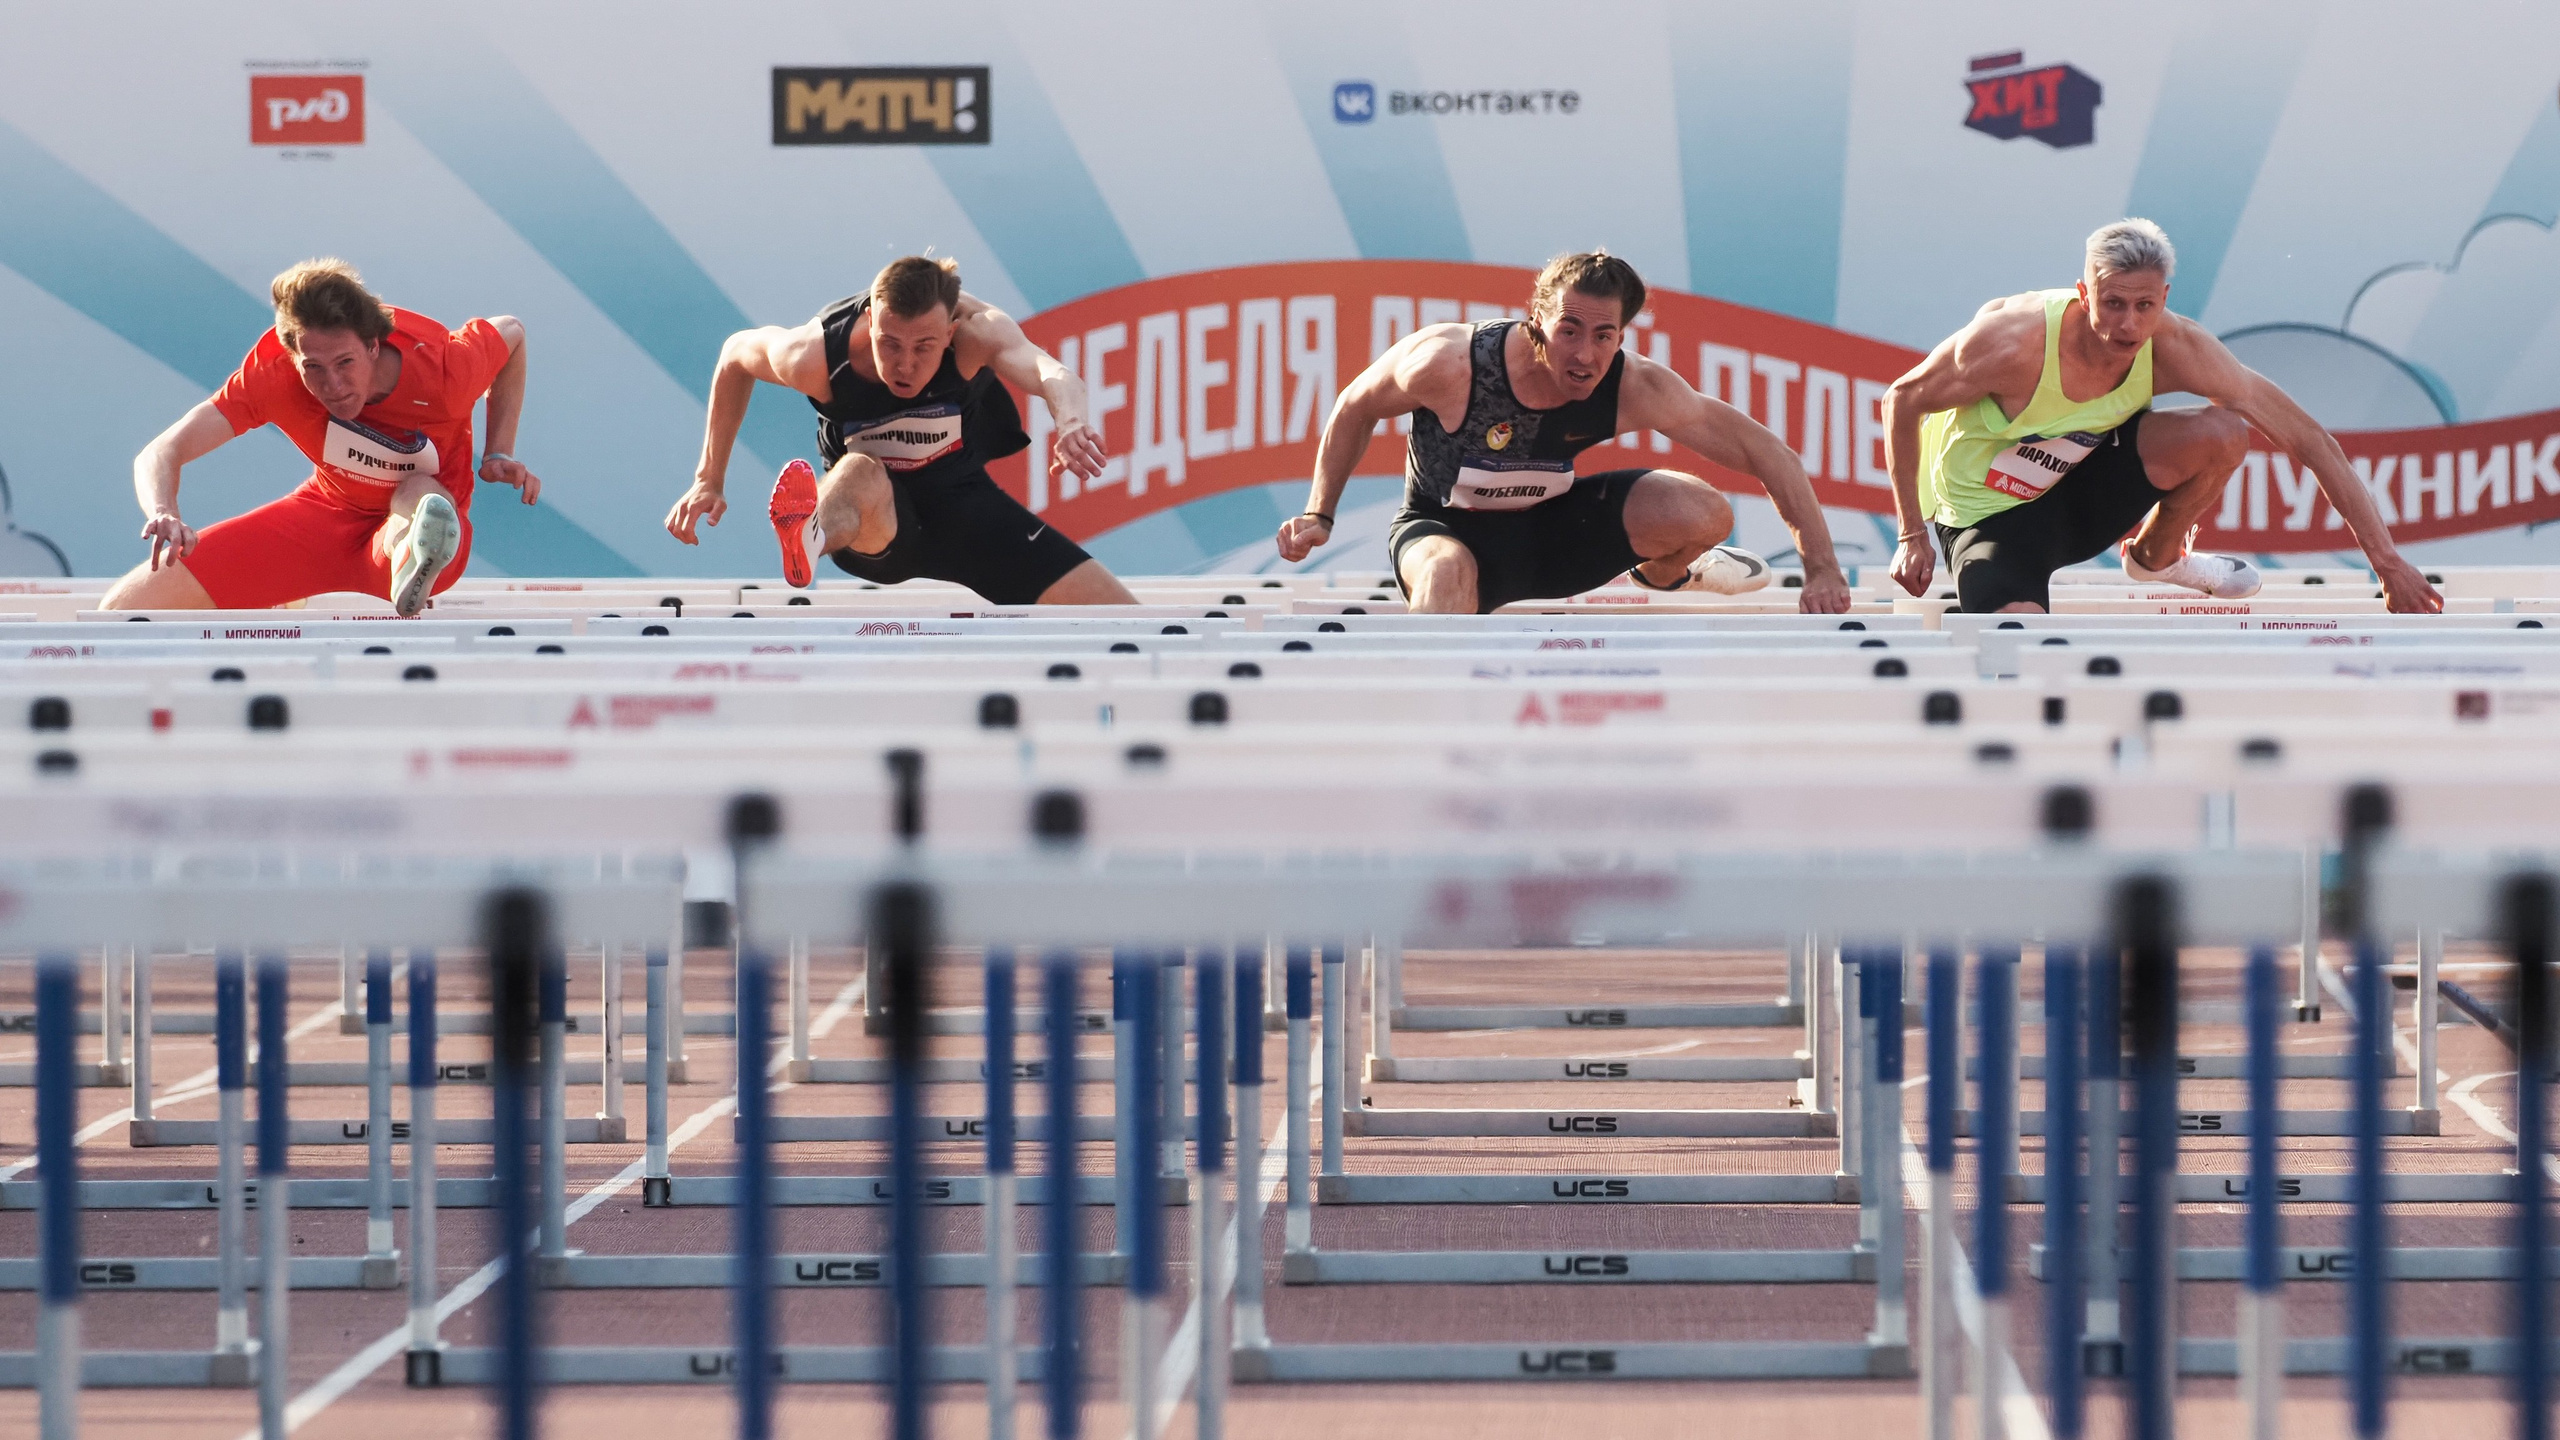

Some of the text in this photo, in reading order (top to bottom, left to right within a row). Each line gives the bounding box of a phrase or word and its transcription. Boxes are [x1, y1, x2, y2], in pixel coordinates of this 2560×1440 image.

[861, 430, 948, 445] СПИРИДОНОВ
[348, 447, 416, 471] РУДЧЕНКО
[1473, 485, 1547, 498] ШУБЕНКОВ
[1566, 1010, 1627, 1026] UCS
[1565, 1062, 1628, 1077] UCS
[343, 1122, 411, 1138] US
[1548, 1116, 1617, 1132] UCS
[2177, 1115, 2222, 1130] CS
[1553, 1180, 1628, 1197] UCS
[2225, 1179, 2301, 1196] US
[796, 1260, 881, 1281] UCS
[1544, 1256, 1628, 1275] UCS
[2298, 1254, 2360, 1273] UC
[80, 1264, 136, 1283] CS
[1519, 1350, 1617, 1373] UCS
